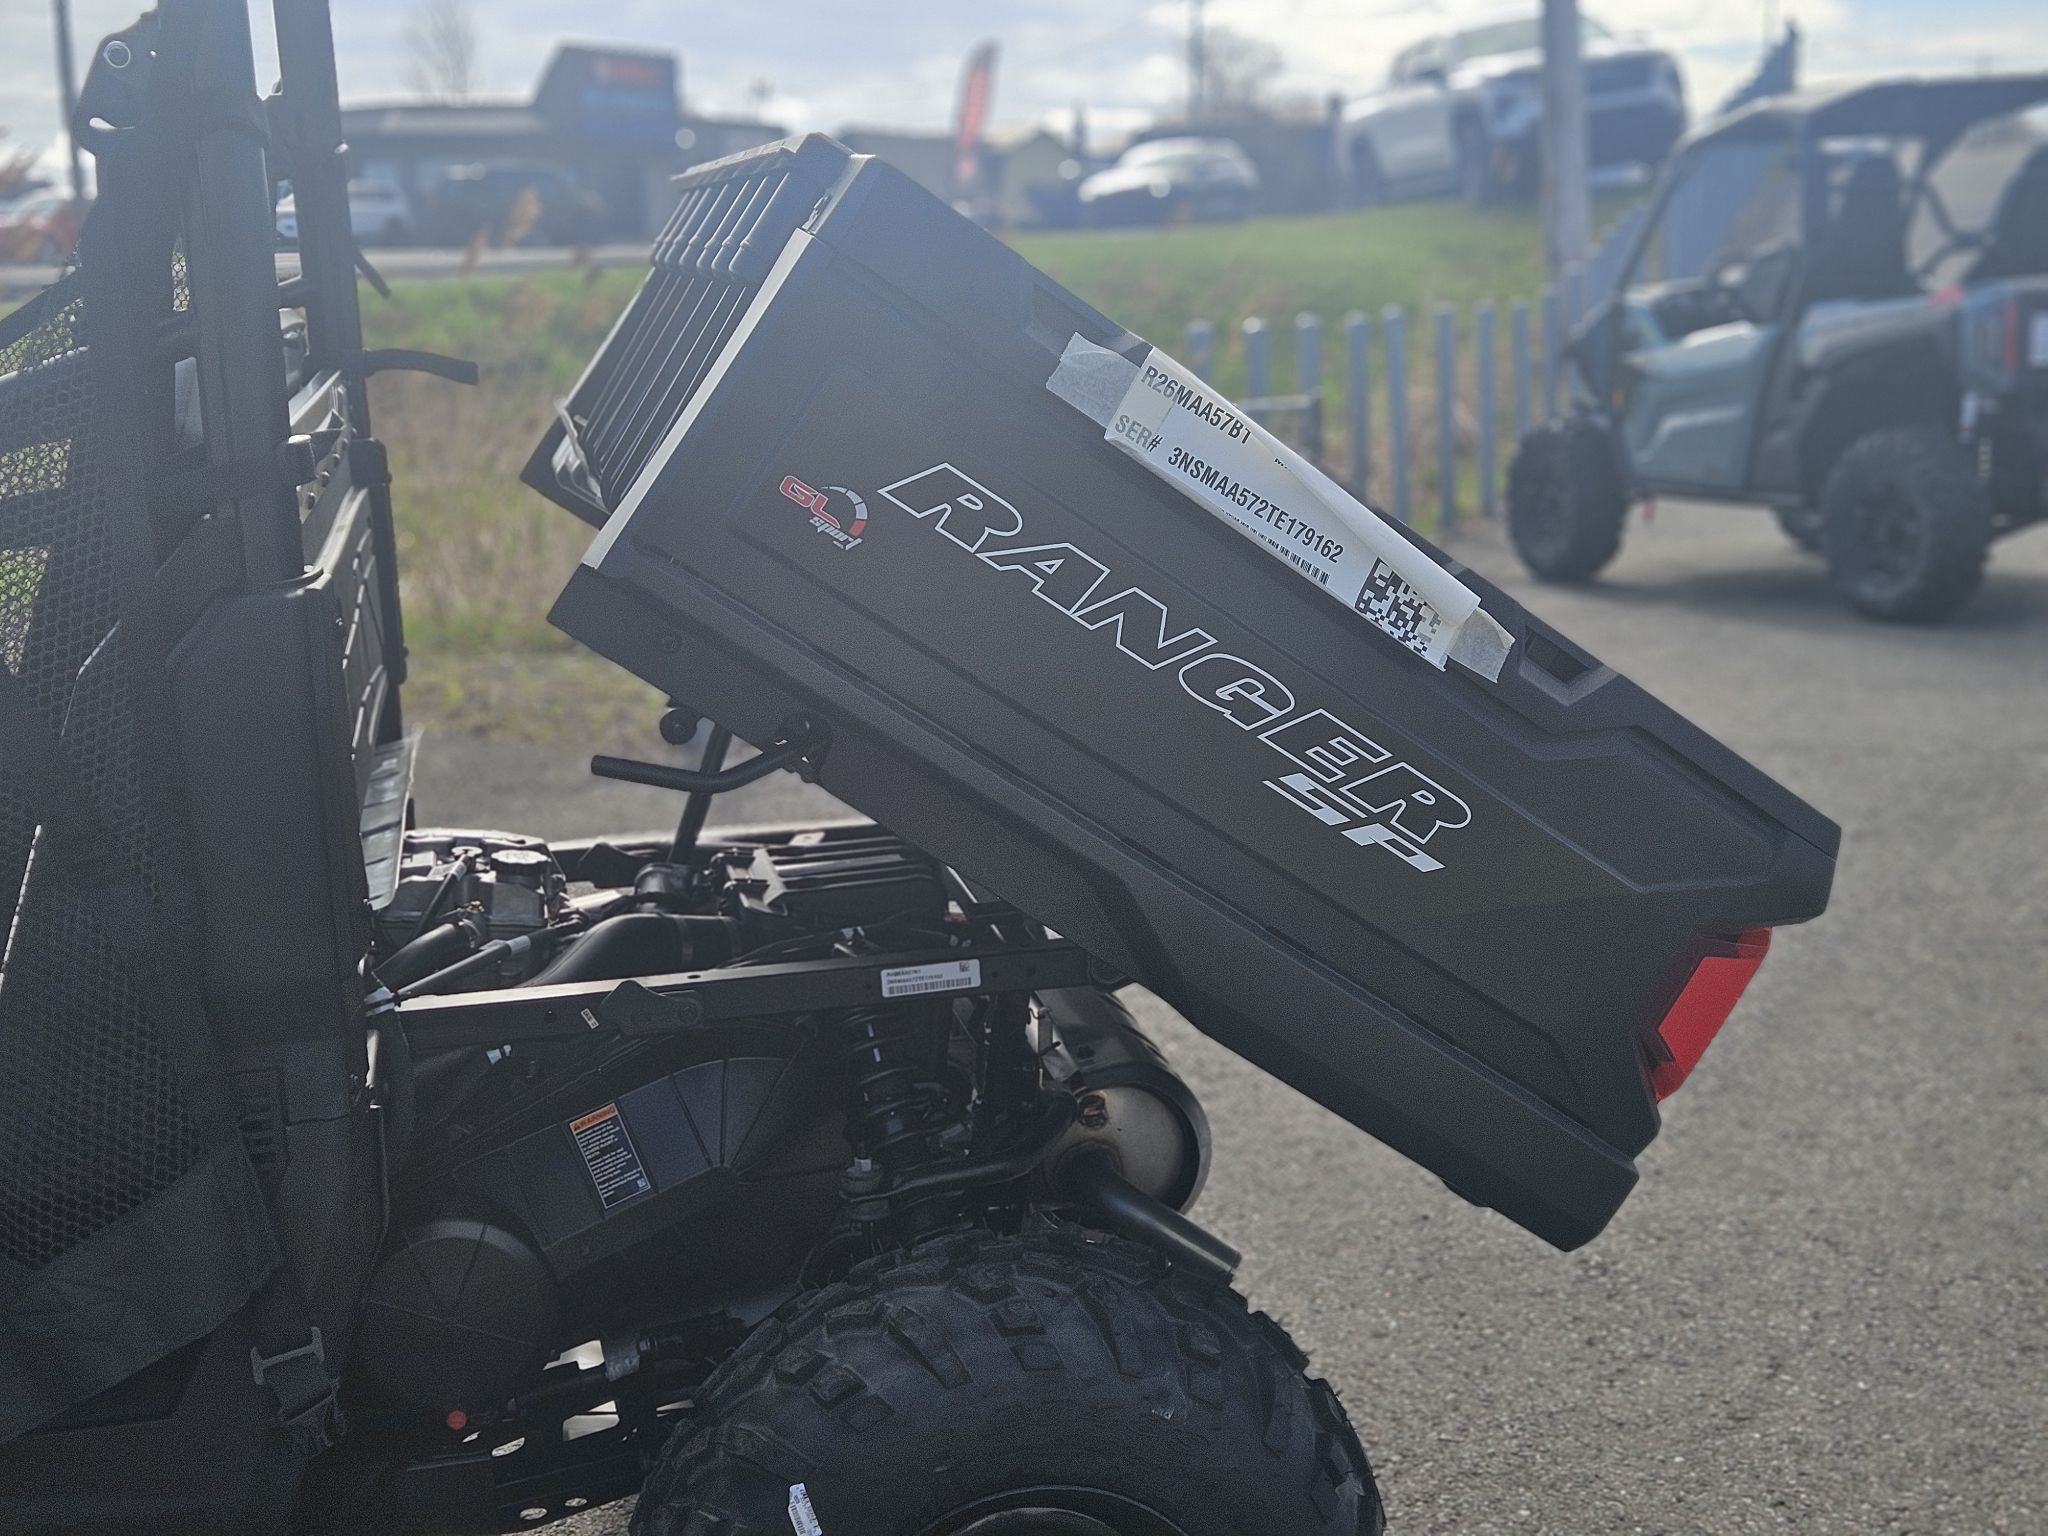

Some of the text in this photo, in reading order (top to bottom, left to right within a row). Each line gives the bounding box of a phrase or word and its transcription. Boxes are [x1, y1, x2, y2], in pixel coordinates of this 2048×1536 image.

[1140, 365, 1252, 445] R26MAA57B1
[1114, 414, 1345, 564] SER# 3NSMAA572TE179162
[876, 462, 1472, 845] RANGER
[1262, 772, 1446, 873] SP
